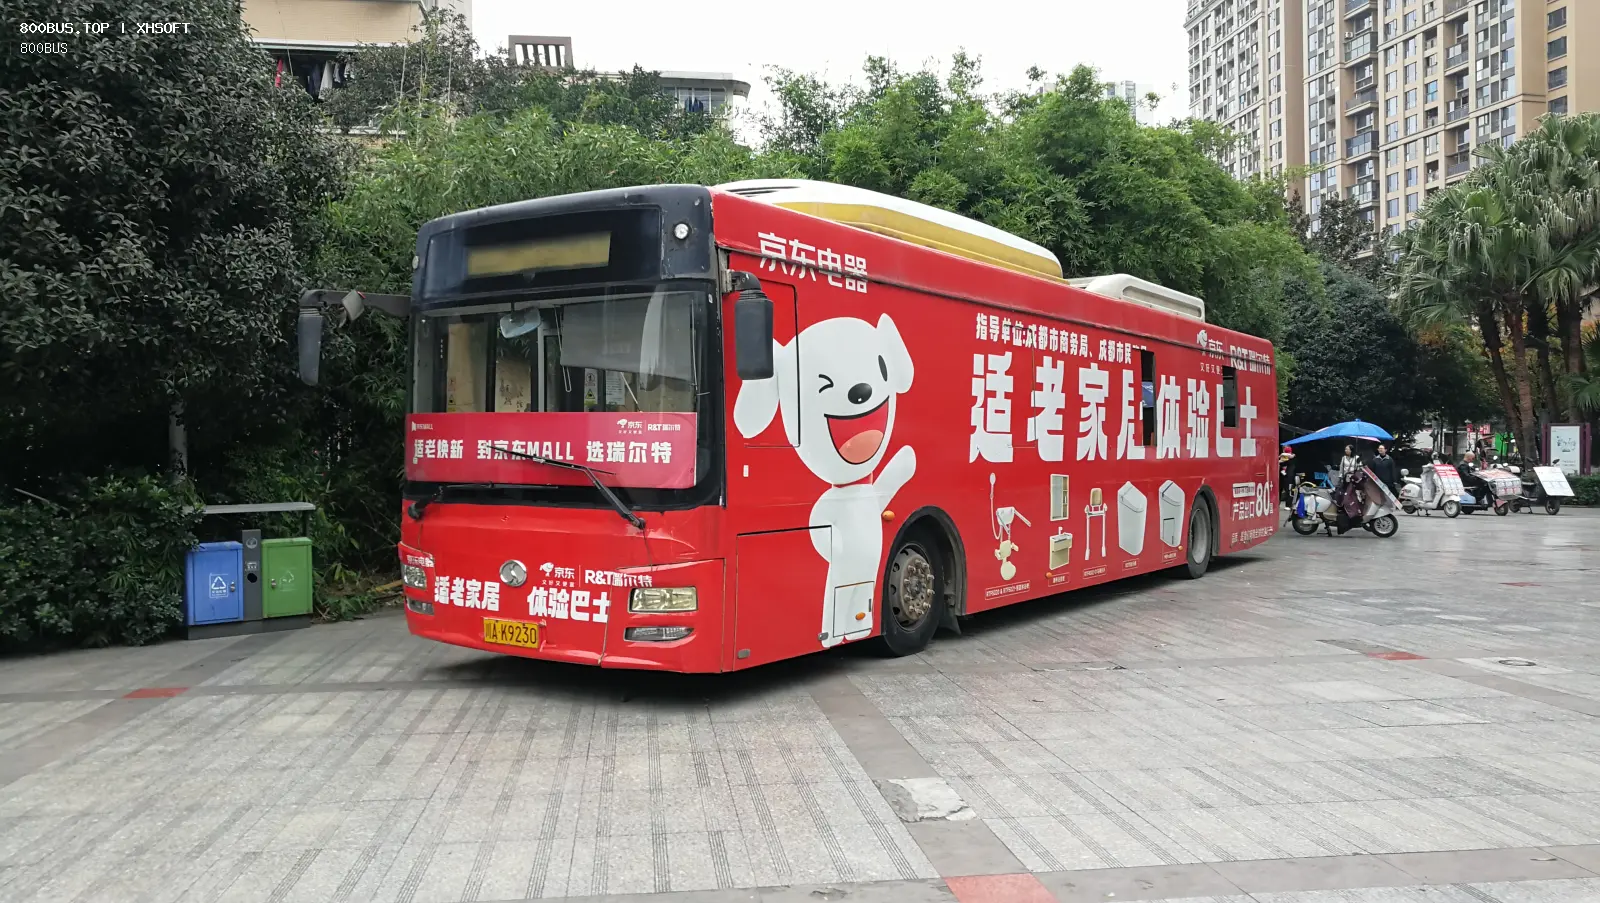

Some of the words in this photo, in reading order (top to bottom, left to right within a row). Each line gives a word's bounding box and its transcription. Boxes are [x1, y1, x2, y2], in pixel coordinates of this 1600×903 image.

[758, 232, 868, 293] 京东电器
[976, 313, 1147, 365] 指导单位:成都市商务局、成都市民
[627, 421, 643, 429] 京东
[413, 439, 463, 461] 适老焕新
[586, 440, 672, 463] 选瑞尔特
[554, 566, 576, 580] 京东
[434, 575, 500, 612] 适老家居
[527, 586, 611, 624] 体验巴士
